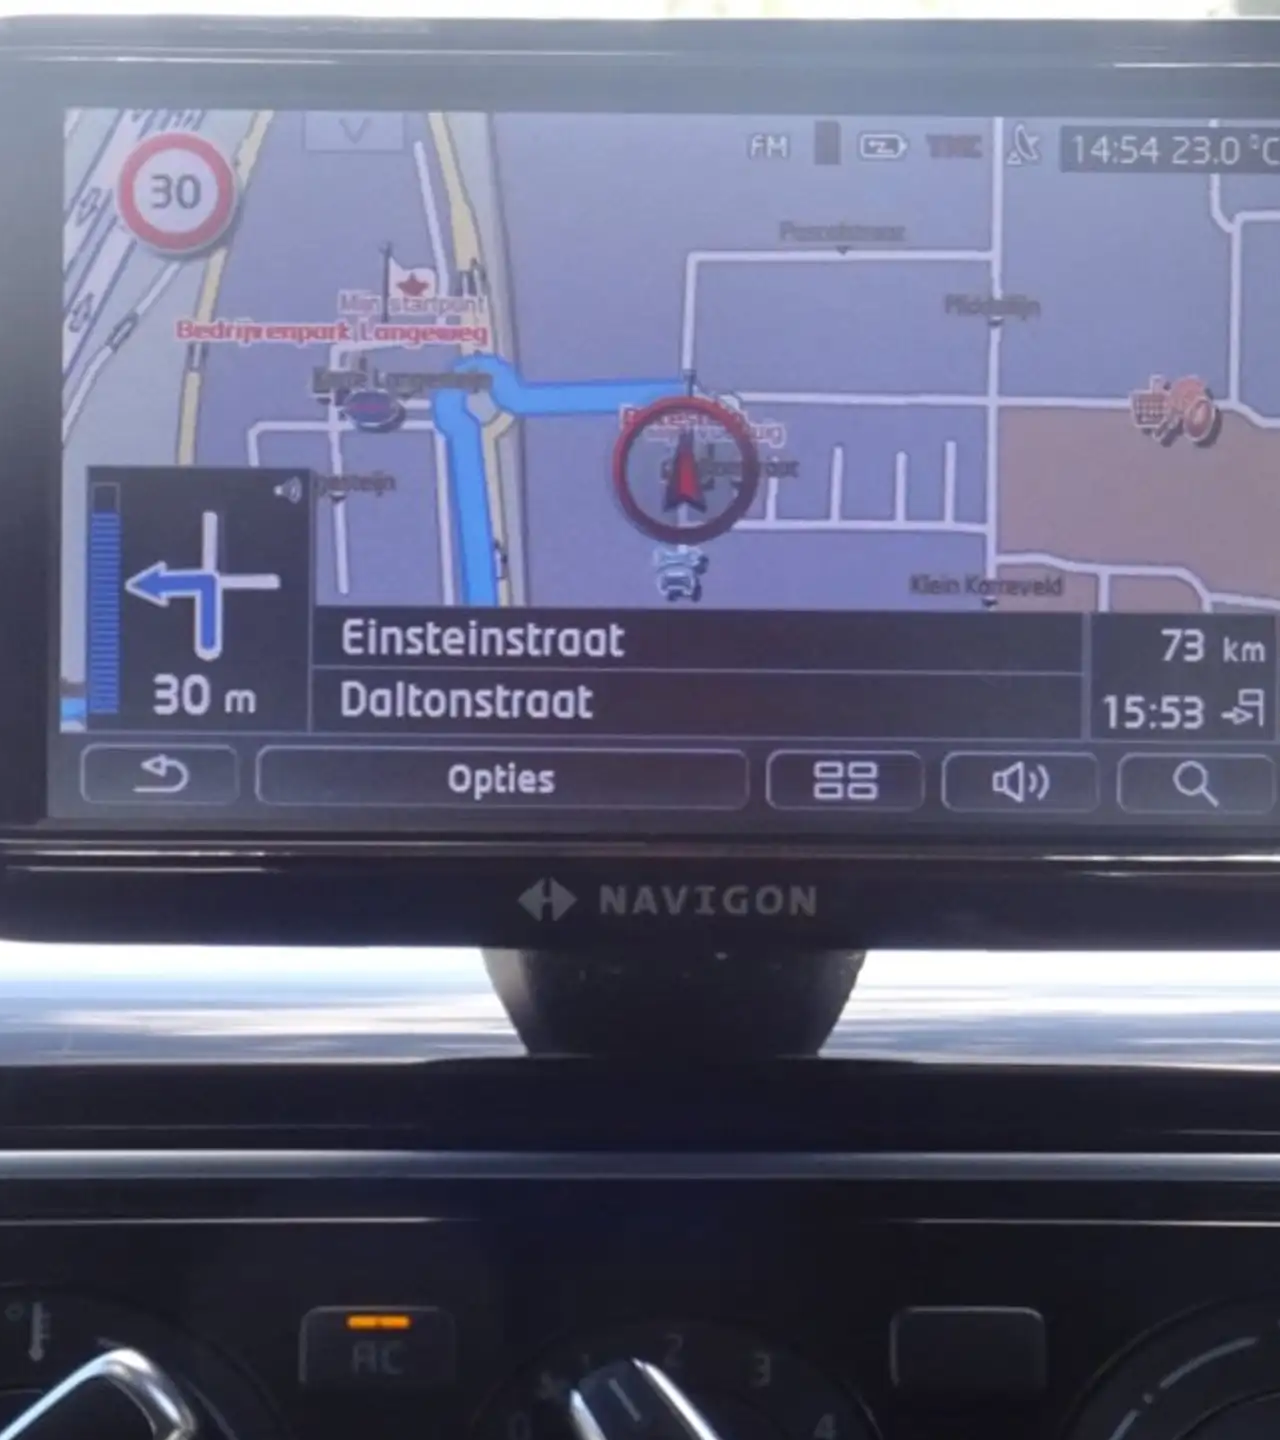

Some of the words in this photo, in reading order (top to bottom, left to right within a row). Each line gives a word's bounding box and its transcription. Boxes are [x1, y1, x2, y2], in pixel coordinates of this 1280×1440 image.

[750, 134, 789, 158] FM
[1072, 134, 1161, 165] 14:54
[1171, 135, 1241, 165] 23.0
[150, 174, 202, 210] 30
[341, 618, 625, 657] Einsteinstraat
[1161, 629, 1205, 663] 73
[1223, 633, 1266, 662] km
[153, 674, 210, 715] 30
[225, 688, 256, 714] m
[341, 680, 594, 719] Daltonstraat
[1103, 694, 1206, 730] 15:53
[447, 764, 556, 800] Opties
[599, 883, 818, 917] NAVIGON
[350, 1340, 407, 1376] AC
[751, 1350, 773, 1388] 3
